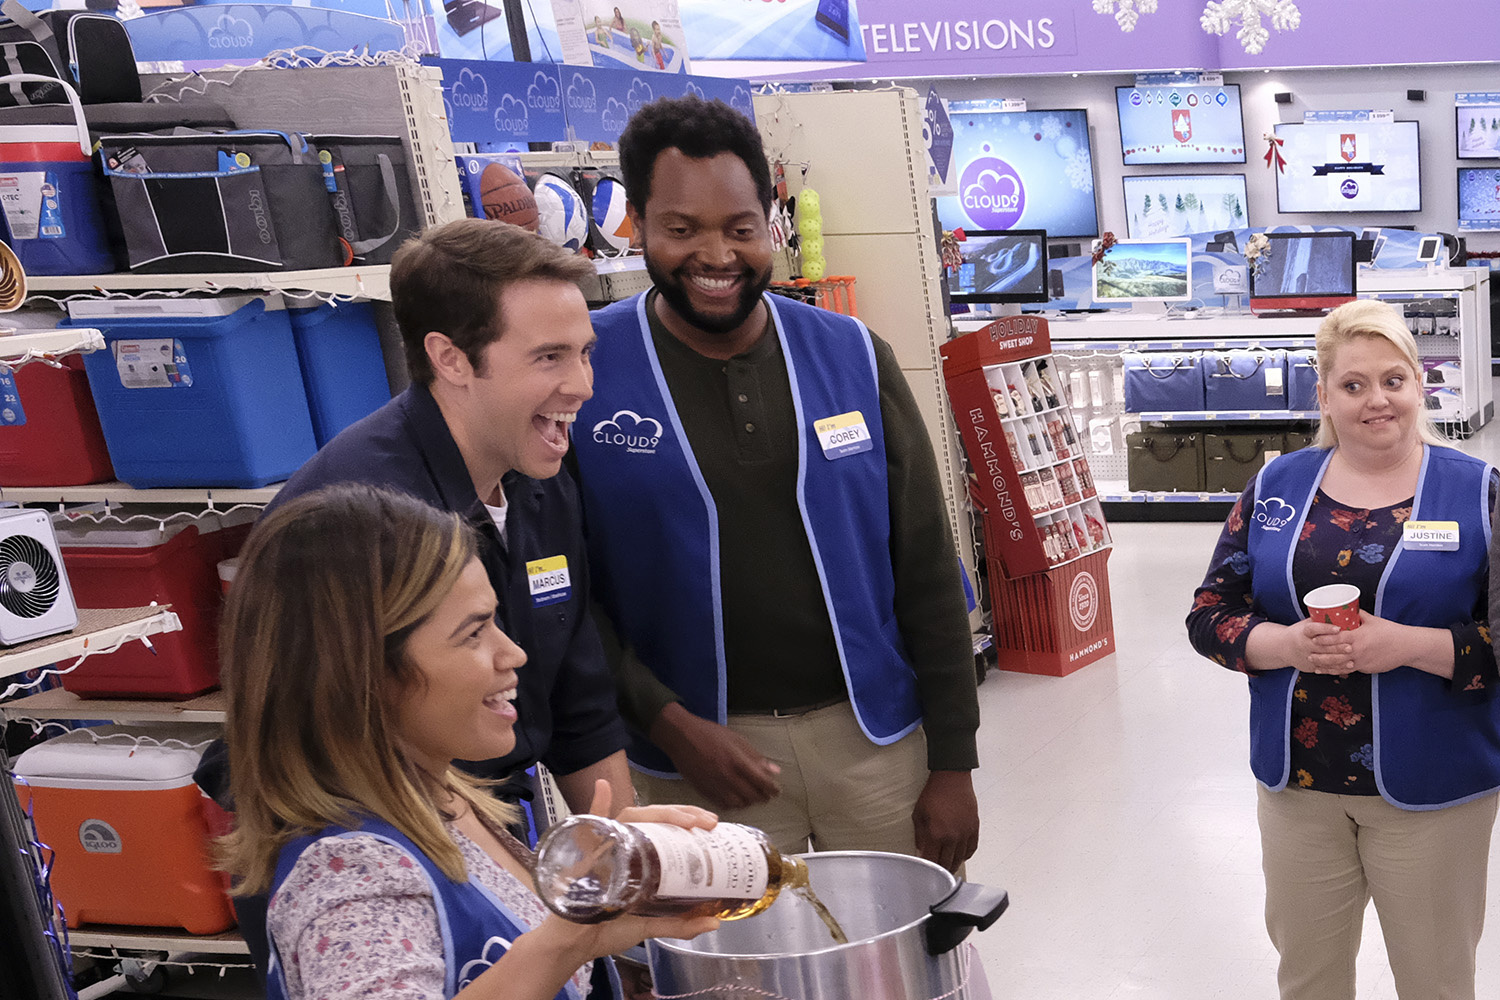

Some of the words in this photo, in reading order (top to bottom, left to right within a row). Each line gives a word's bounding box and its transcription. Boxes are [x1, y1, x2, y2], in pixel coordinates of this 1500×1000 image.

[208, 36, 254, 48] CLOUD9
[860, 18, 1055, 53] TELEVISIONS
[452, 93, 488, 107] CLOUD9
[527, 94, 560, 108] CLOUD9
[567, 95, 596, 109] CLOUD9
[494, 117, 529, 132] CLOUD9
[964, 195, 1020, 209] CLOUD9
[989, 318, 1039, 342] HOLIDAY
[999, 339, 1018, 351] SWEET
[1018, 336, 1034, 348] SHOP
[593, 431, 659, 448] CLOUD9
[829, 428, 860, 445] COREY
[969, 407, 1024, 542] HAMMOND'S
[1251, 511, 1287, 527] LOUD9
[1410, 532, 1453, 540] JUSTINE
[532, 573, 566, 591] MARCUS
[1069, 638, 1108, 662] HAMMOND'S
[85, 841, 117, 851] IGLOO
[724, 841, 738, 889] WOOD
